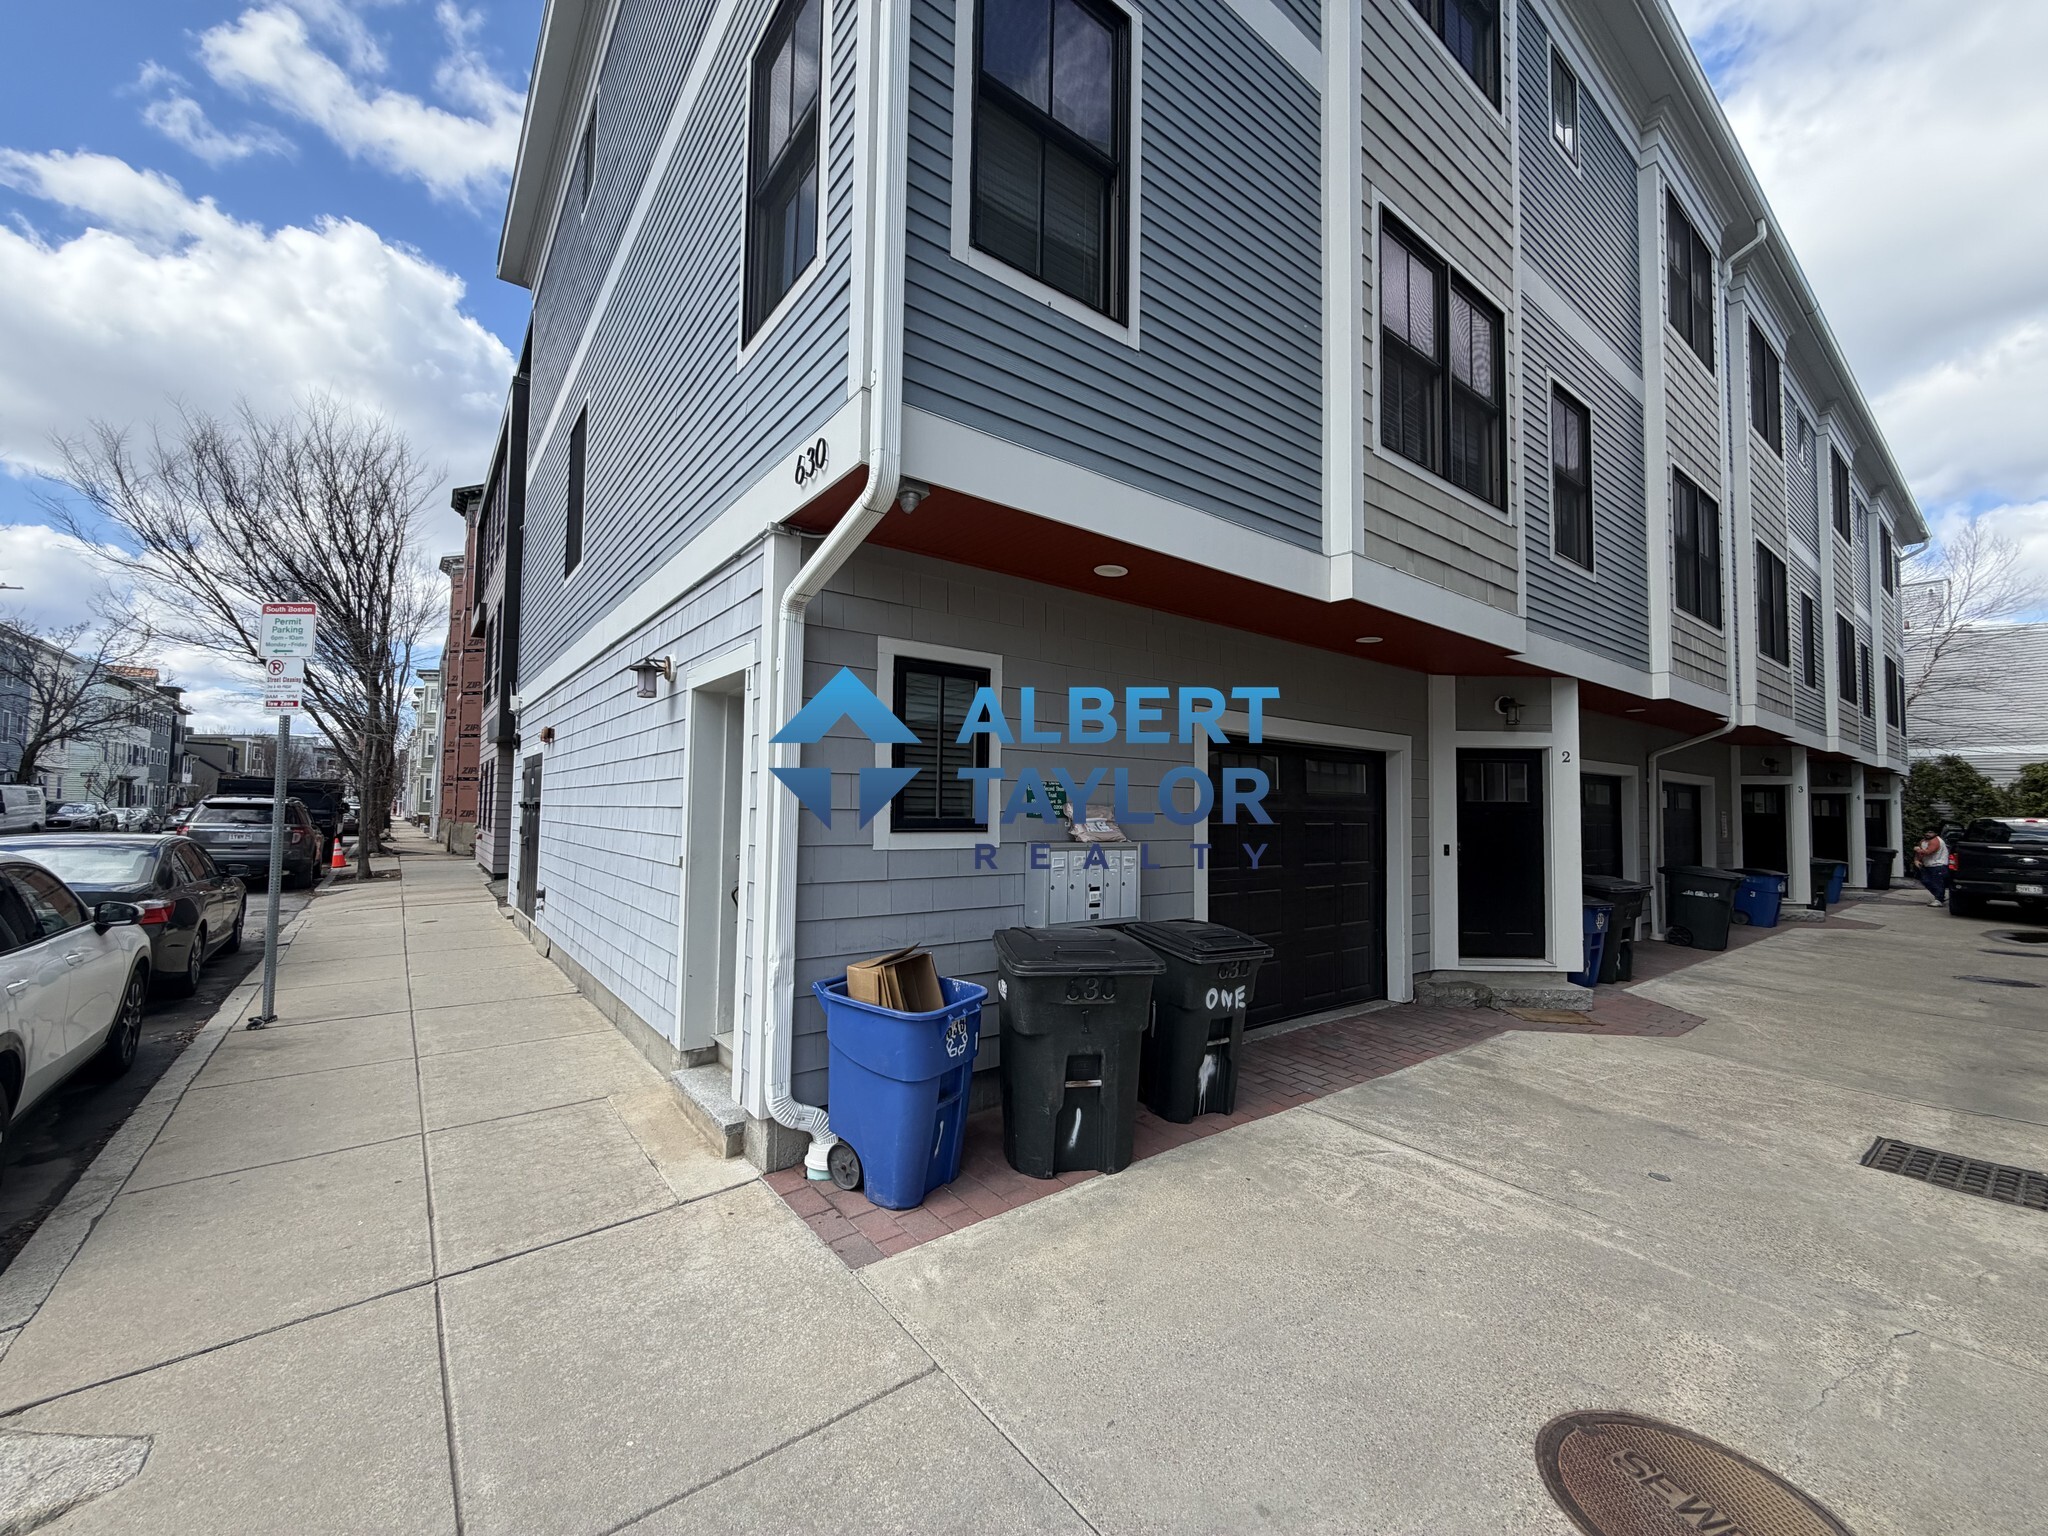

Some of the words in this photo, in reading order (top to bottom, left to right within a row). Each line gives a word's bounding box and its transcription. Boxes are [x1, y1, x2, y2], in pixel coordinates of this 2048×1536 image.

[794, 437, 827, 486] 630
[265, 605, 287, 613] South
[288, 605, 313, 613] Boston
[271, 625, 304, 635] Parking
[1561, 750, 1571, 763] 2
[1797, 785, 1804, 793] 3
[1205, 985, 1246, 1012] ONE
[1611, 1451, 1748, 1536] SEW
